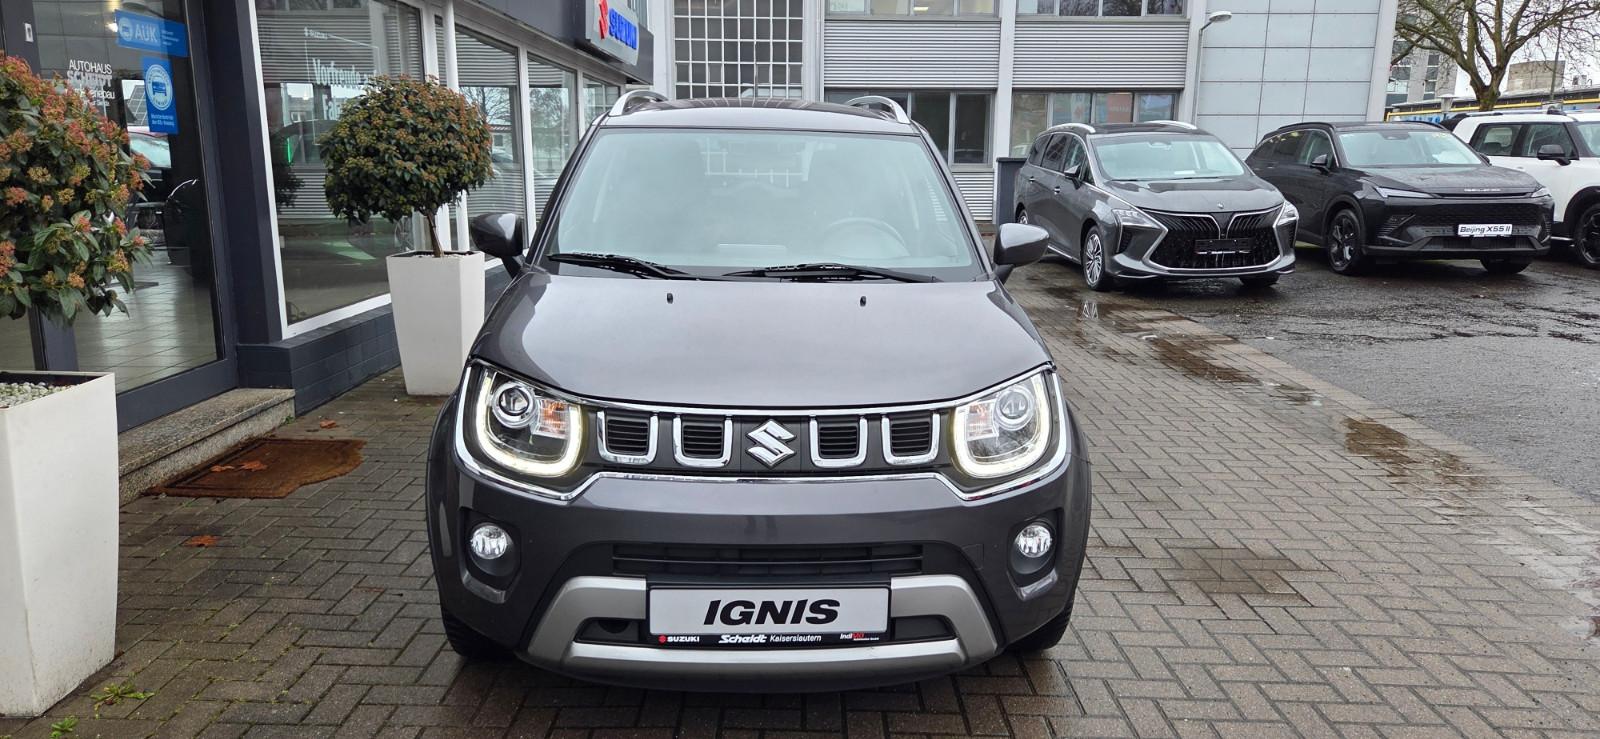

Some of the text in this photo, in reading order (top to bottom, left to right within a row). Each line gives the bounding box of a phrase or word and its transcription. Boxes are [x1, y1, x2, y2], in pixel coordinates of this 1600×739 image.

[609, 8, 637, 50] SUZUKI
[69, 59, 112, 75] AUTOHAUS
[313, 57, 361, 88] Vorfreude
[1460, 226, 1485, 234] Beijing
[704, 598, 840, 626] IGNIS
[667, 635, 700, 643] SUZUKI
[769, 634, 822, 643] Kaiserslautern
